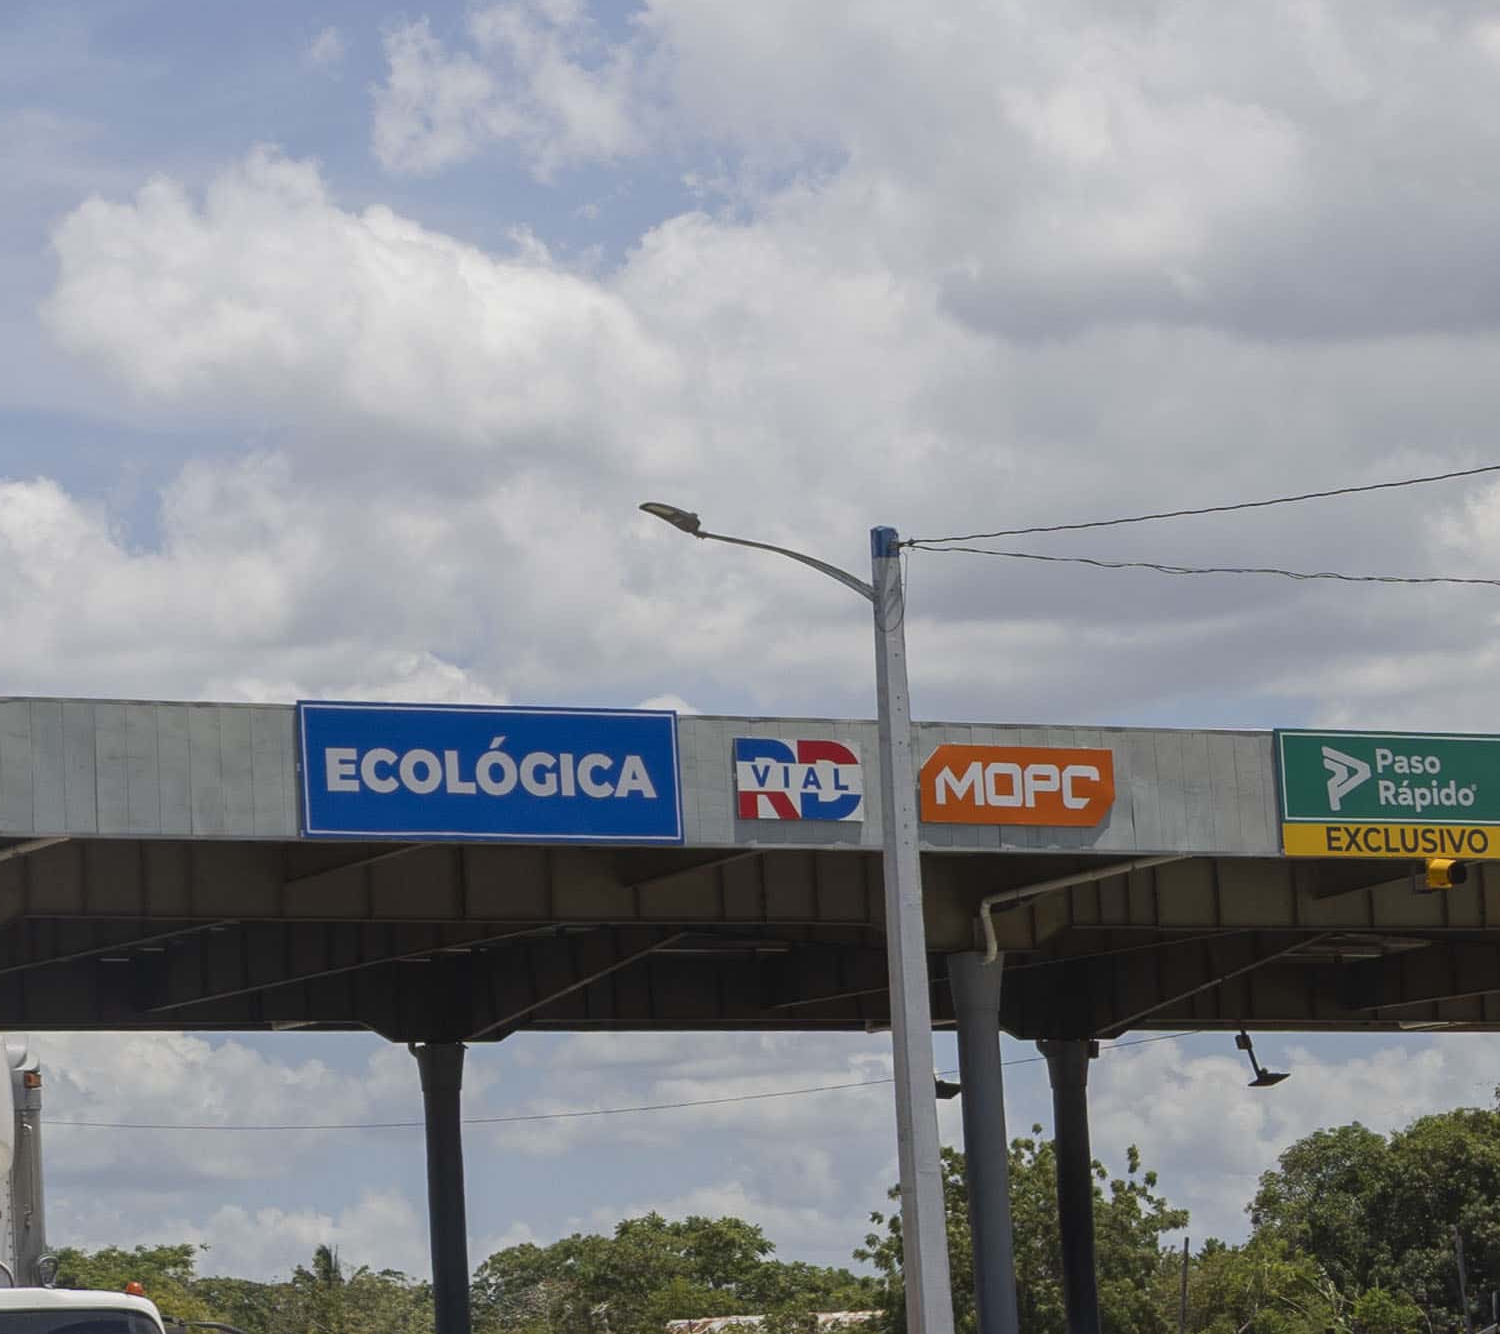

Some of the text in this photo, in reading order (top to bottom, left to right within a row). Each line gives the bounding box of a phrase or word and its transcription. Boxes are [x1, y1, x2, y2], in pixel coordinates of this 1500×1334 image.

[324, 735, 657, 799] ECOLÓGICA
[751, 764, 849, 791] VIAL
[1375, 748, 1441, 775] Paso
[935, 761, 1100, 810] MOPC
[1378, 779, 1475, 814] Rápido
[1326, 826, 1489, 855] EXCLUSIVO
